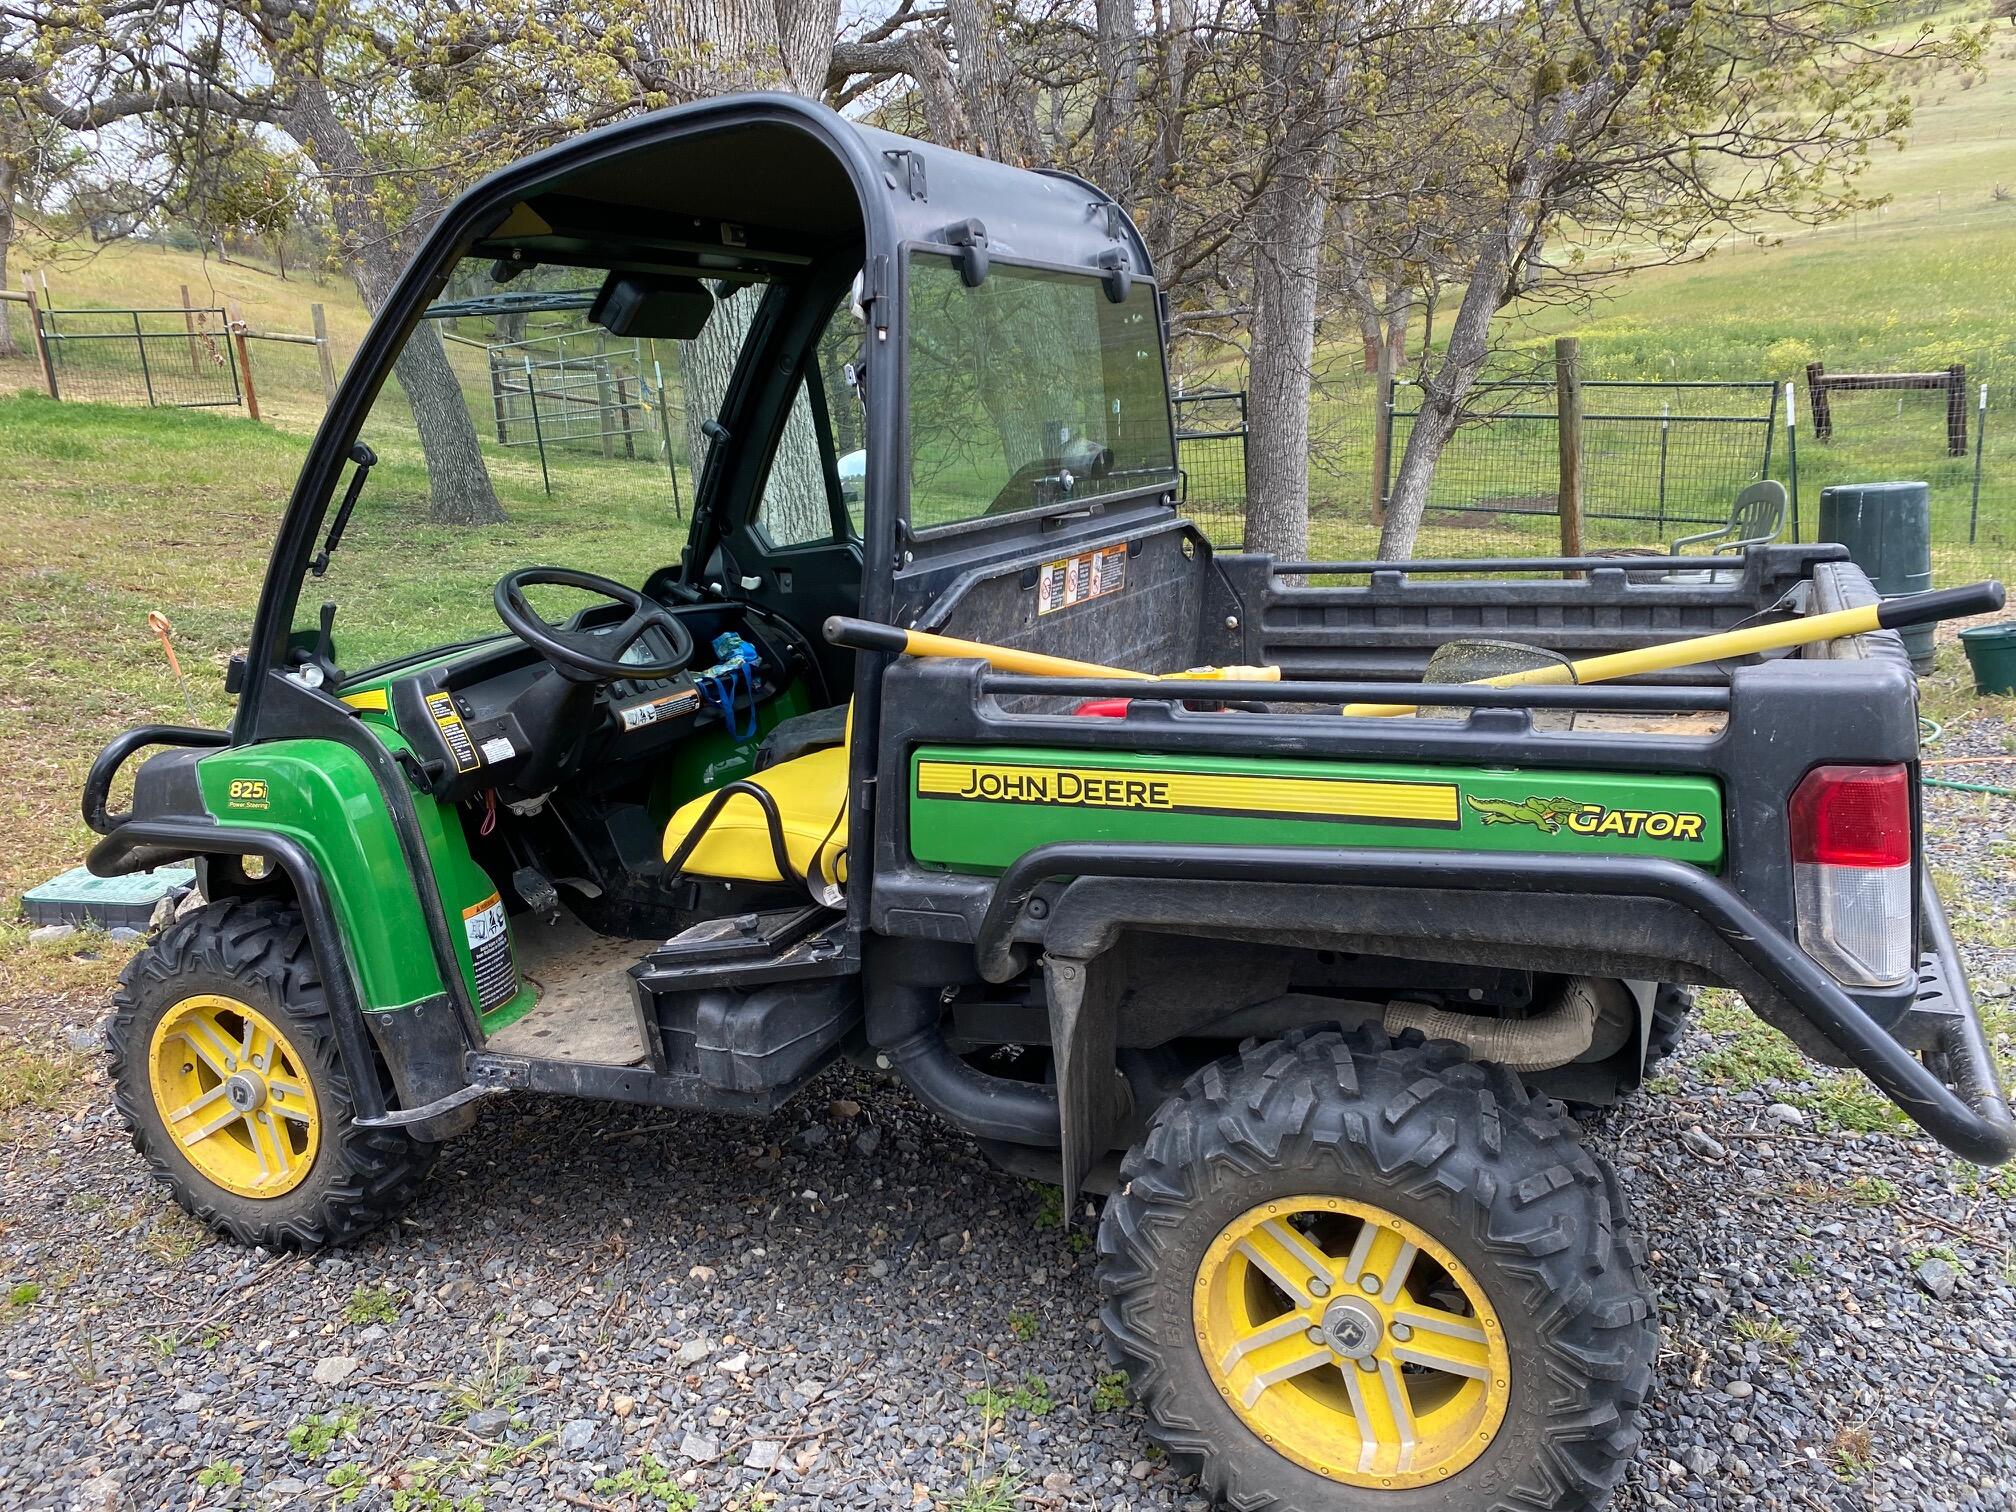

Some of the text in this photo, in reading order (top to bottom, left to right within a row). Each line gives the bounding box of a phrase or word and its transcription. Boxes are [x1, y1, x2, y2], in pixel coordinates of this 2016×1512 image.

[229, 780, 267, 799] 825i
[961, 768, 1170, 806] JOHN DEERE
[1567, 804, 1704, 840] GATOR
